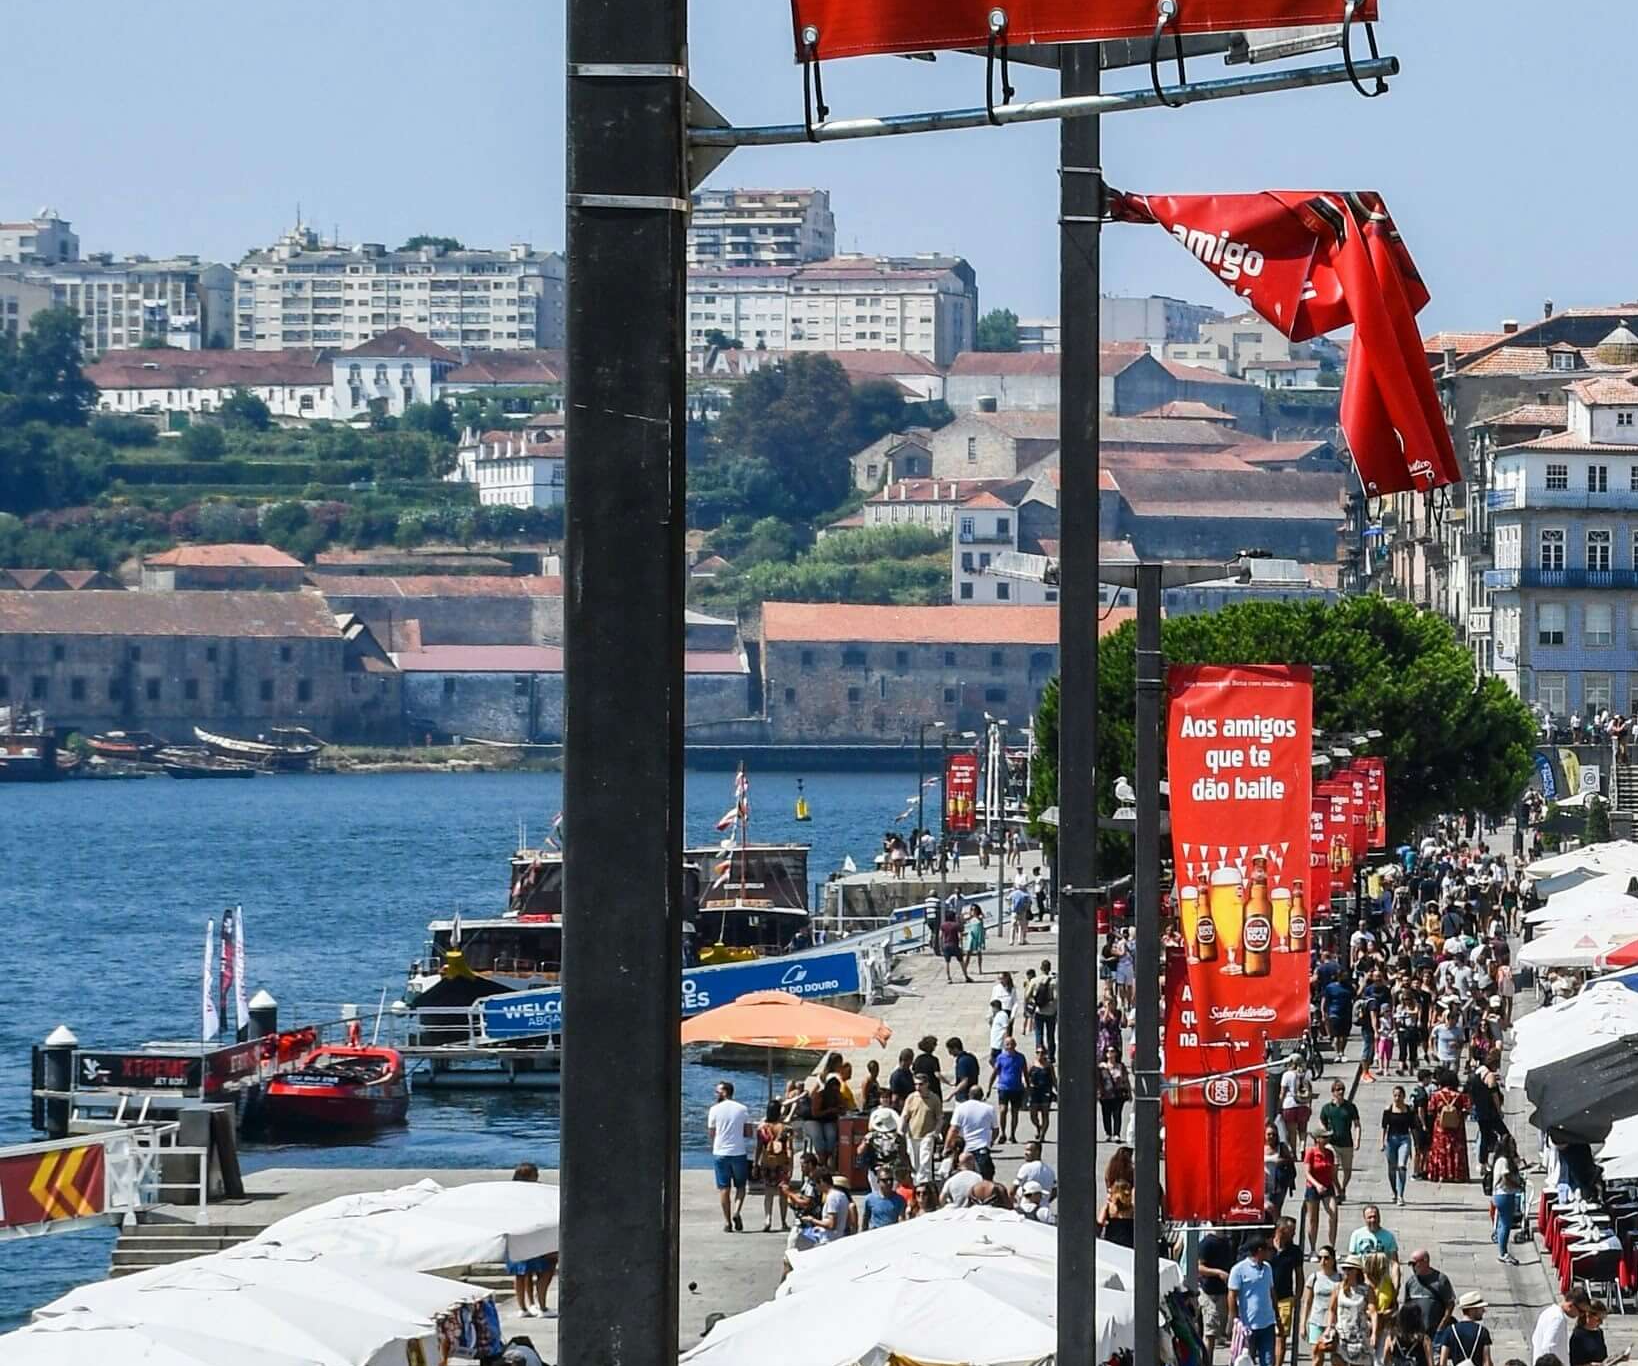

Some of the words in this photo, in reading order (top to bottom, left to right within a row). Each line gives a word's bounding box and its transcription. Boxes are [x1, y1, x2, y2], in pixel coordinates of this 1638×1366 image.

[1181, 715, 1218, 738] Aos
[1222, 715, 1297, 744] amigos
[1205, 748, 1244, 775] que
[1248, 744, 1271, 768] te
[1192, 776, 1229, 801] dão
[1234, 775, 1285, 800] baile
[804, 980, 839, 992] DOURO
[122, 1058, 192, 1077] XTREME
